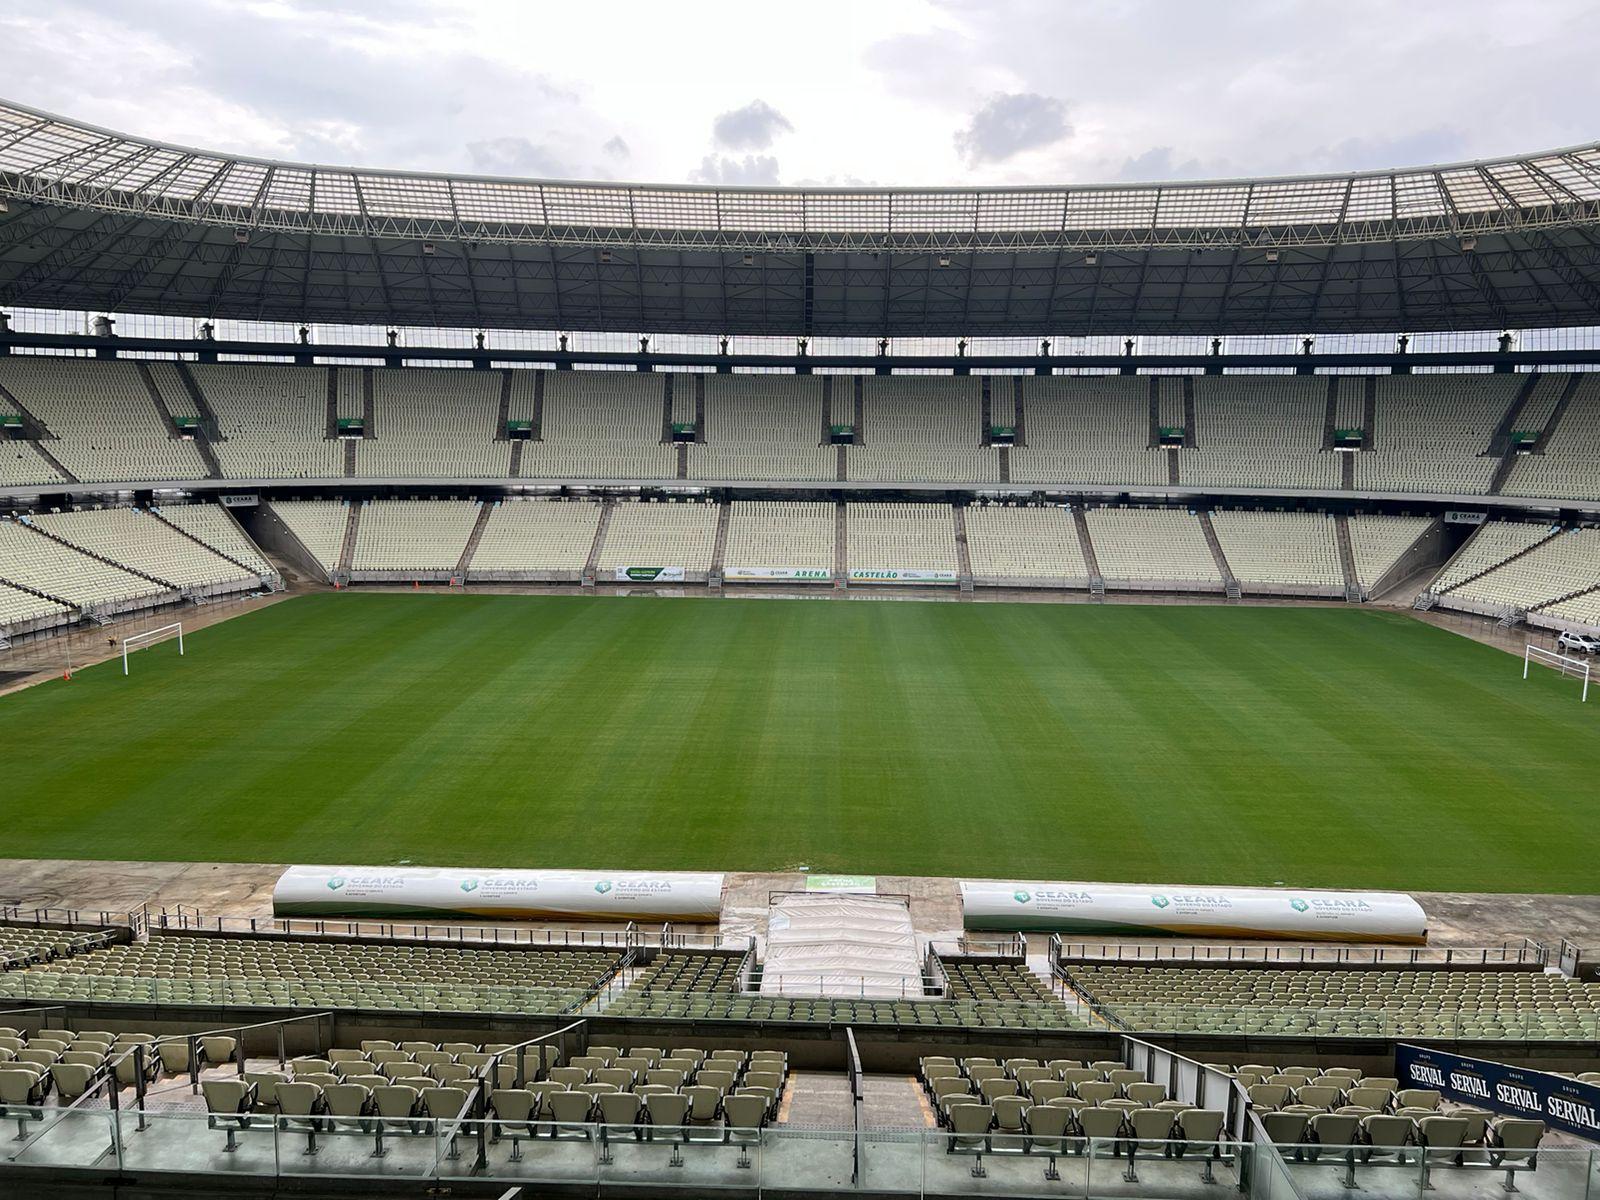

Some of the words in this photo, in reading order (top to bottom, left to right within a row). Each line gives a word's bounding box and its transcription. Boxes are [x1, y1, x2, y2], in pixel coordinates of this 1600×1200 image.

[853, 571, 898, 579] CASTELÃO
[1409, 1063, 1446, 1087] SERVAL
[1450, 1072, 1491, 1098] SERVAL
[1496, 1083, 1542, 1112] SERVAL
[1547, 1096, 1600, 1130] SERVAL
